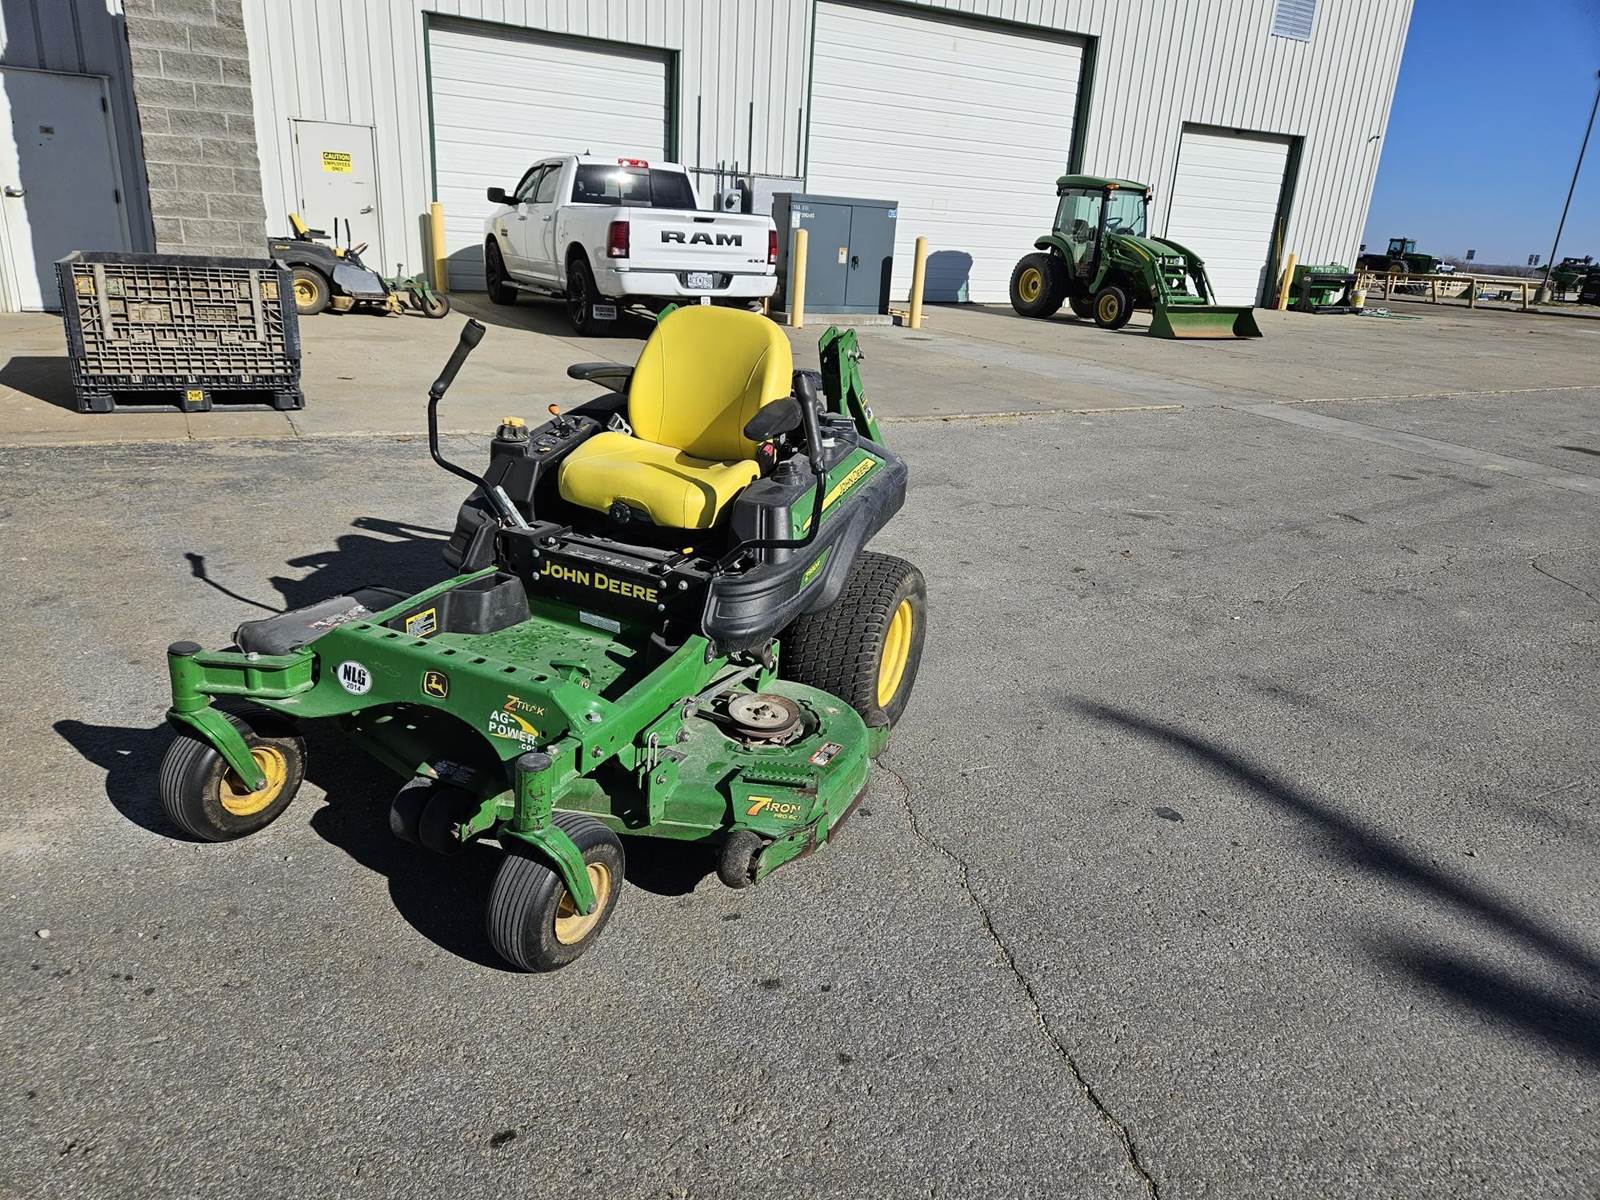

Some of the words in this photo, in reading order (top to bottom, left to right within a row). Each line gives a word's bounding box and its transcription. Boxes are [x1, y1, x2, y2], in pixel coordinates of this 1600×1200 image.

[323, 152, 350, 161] CAUTION
[661, 230, 742, 247] RAM
[540, 560, 590, 586] JOHN
[594, 572, 658, 603] DEERE
[343, 664, 367, 686] NLG
[346, 681, 361, 691] 2014
[490, 710, 515, 724] AG-
[488, 721, 537, 745] POWER
